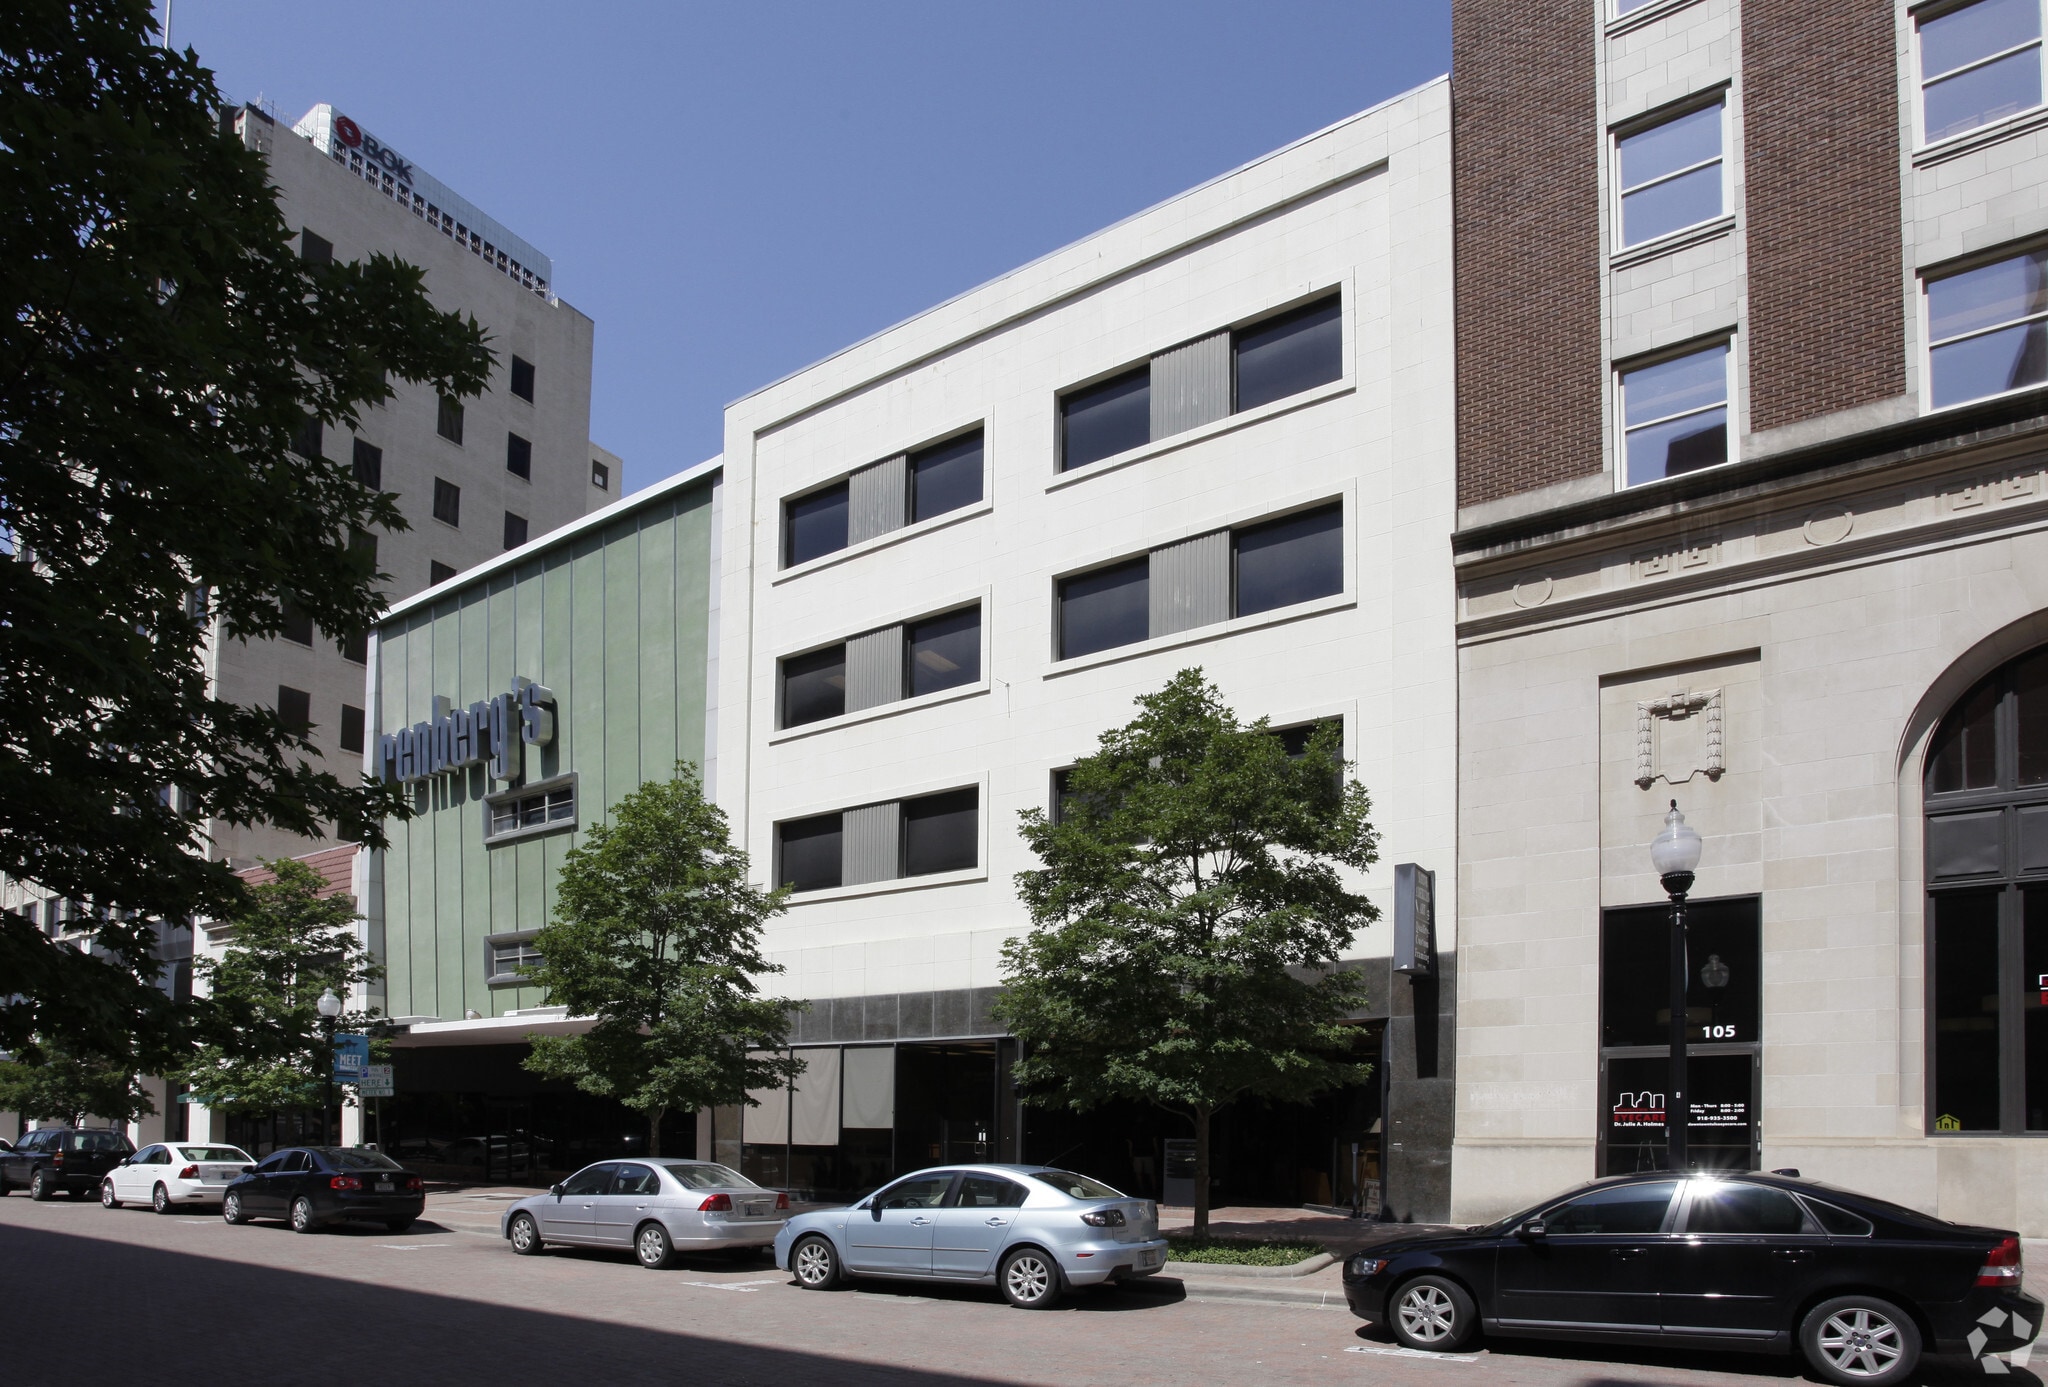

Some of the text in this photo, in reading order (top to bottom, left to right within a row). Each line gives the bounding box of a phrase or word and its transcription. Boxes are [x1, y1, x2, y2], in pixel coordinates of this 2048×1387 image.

[363, 134, 414, 186] BOK
[379, 677, 552, 784] renberg's
[1703, 1025, 1736, 1038] 105
[340, 1054, 362, 1066] MEET
[361, 1079, 381, 1087] HERE
[1614, 1114, 1666, 1122] EYECARE
